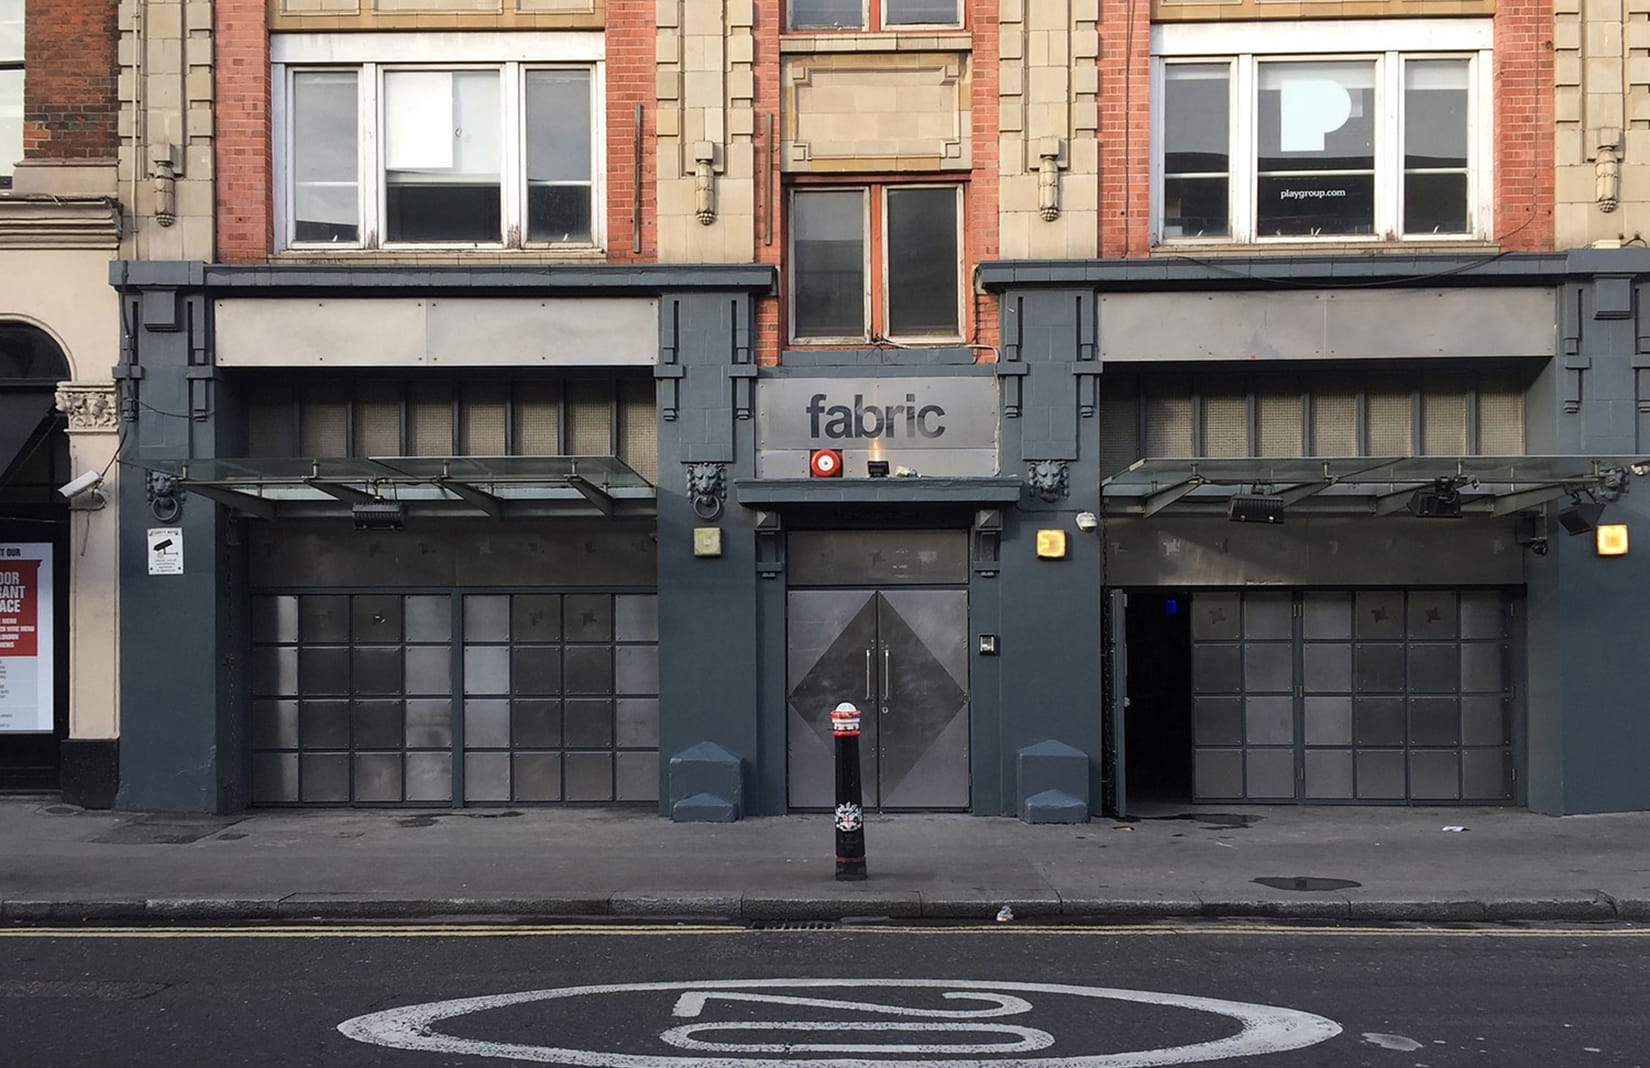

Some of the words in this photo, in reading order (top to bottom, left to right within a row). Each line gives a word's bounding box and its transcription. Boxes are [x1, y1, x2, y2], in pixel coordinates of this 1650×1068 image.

[1281, 80, 1352, 152] P
[1280, 188, 1346, 199] playgroup.com
[806, 393, 946, 439] fabric
